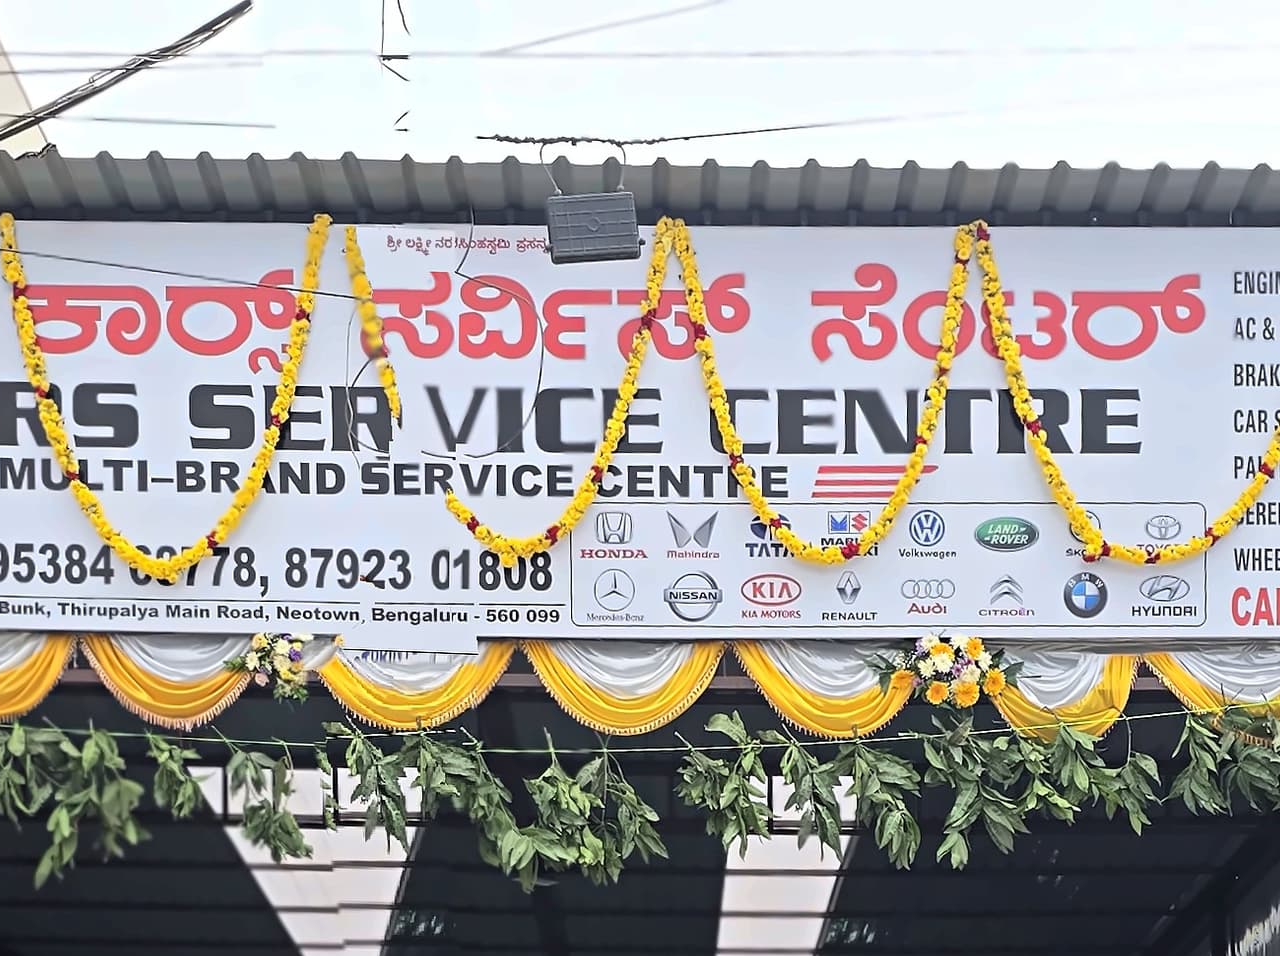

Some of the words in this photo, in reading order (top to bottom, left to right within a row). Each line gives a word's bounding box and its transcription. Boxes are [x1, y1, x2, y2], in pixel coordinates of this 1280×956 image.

[1233, 318, 1256, 340] AC
[710, 387, 1143, 455] CENTRE
[1233, 410, 1268, 433] CAR
[360, 462, 576, 499] SERVICE
[600, 465, 790, 498] CENTRE
[987, 524, 1018, 534] LAND
[990, 535, 1029, 544] ROVER
[580, 549, 648, 559] HONDA
[667, 550, 720, 558] Mahindra
[899, 549, 957, 559] Volkswagen
[752, 582, 792, 599] KIA
[669, 591, 718, 601] NISSAN
[907, 603, 946, 614] Audi
[56, 602, 159, 622] Thirupalya
[166, 605, 210, 618] Main
[217, 606, 270, 622] Road,
[277, 606, 366, 624] Neotown,
[371, 608, 468, 626] Bengaluru
[486, 609, 520, 622] 560
[527, 609, 559, 623] 099
[741, 610, 757, 619] KIA
[760, 610, 801, 619] MOTORS
[822, 612, 877, 621] RENAULT
